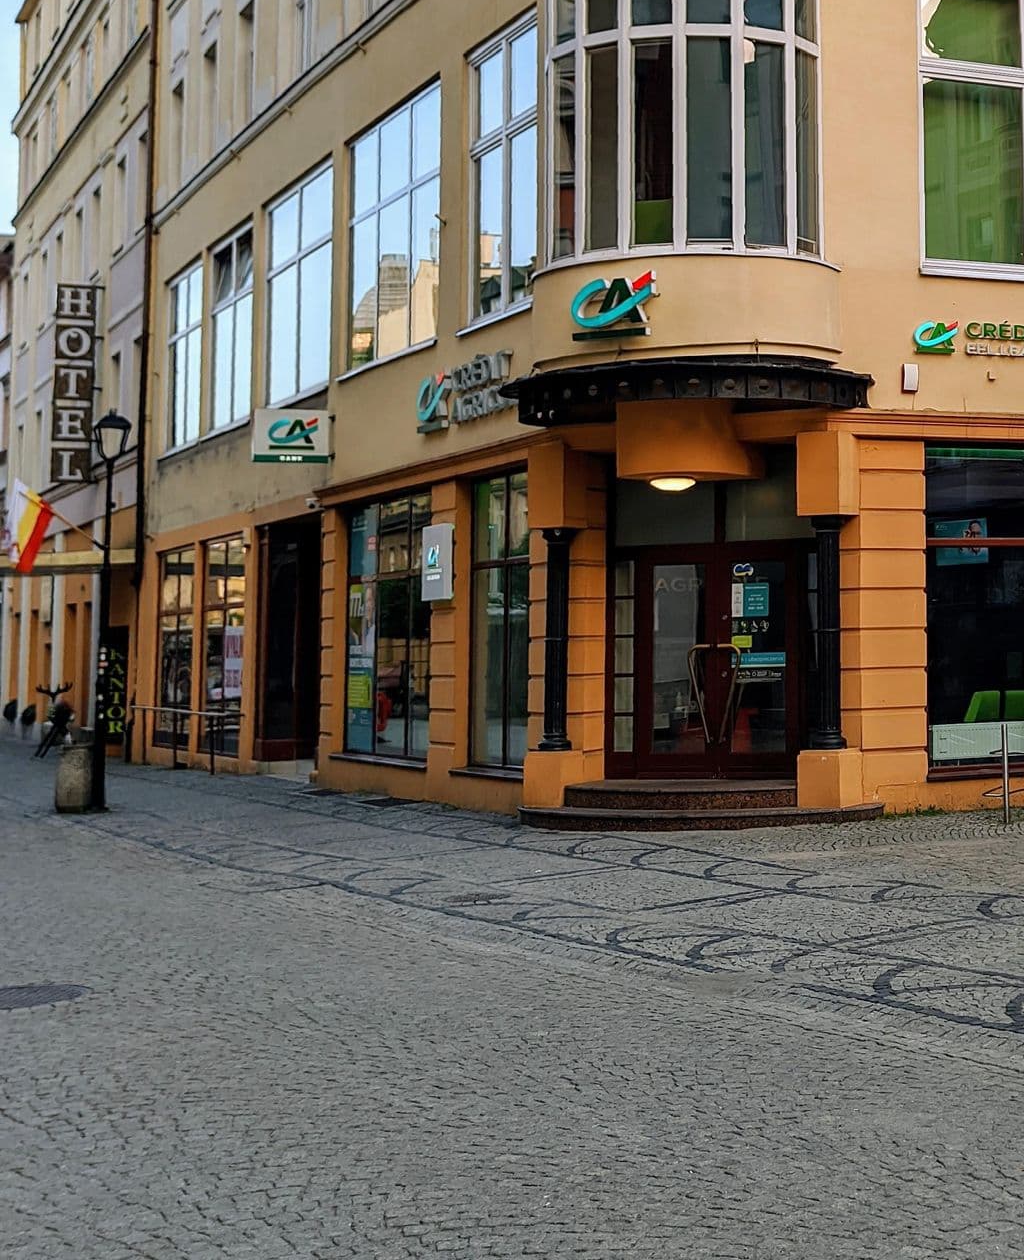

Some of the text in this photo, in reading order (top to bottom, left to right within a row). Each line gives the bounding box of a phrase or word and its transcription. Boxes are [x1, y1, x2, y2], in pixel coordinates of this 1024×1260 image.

[58, 288, 92, 481] HOTEL
[451, 349, 514, 392] CRÉDIT
[106, 647, 126, 733] KANTOR
